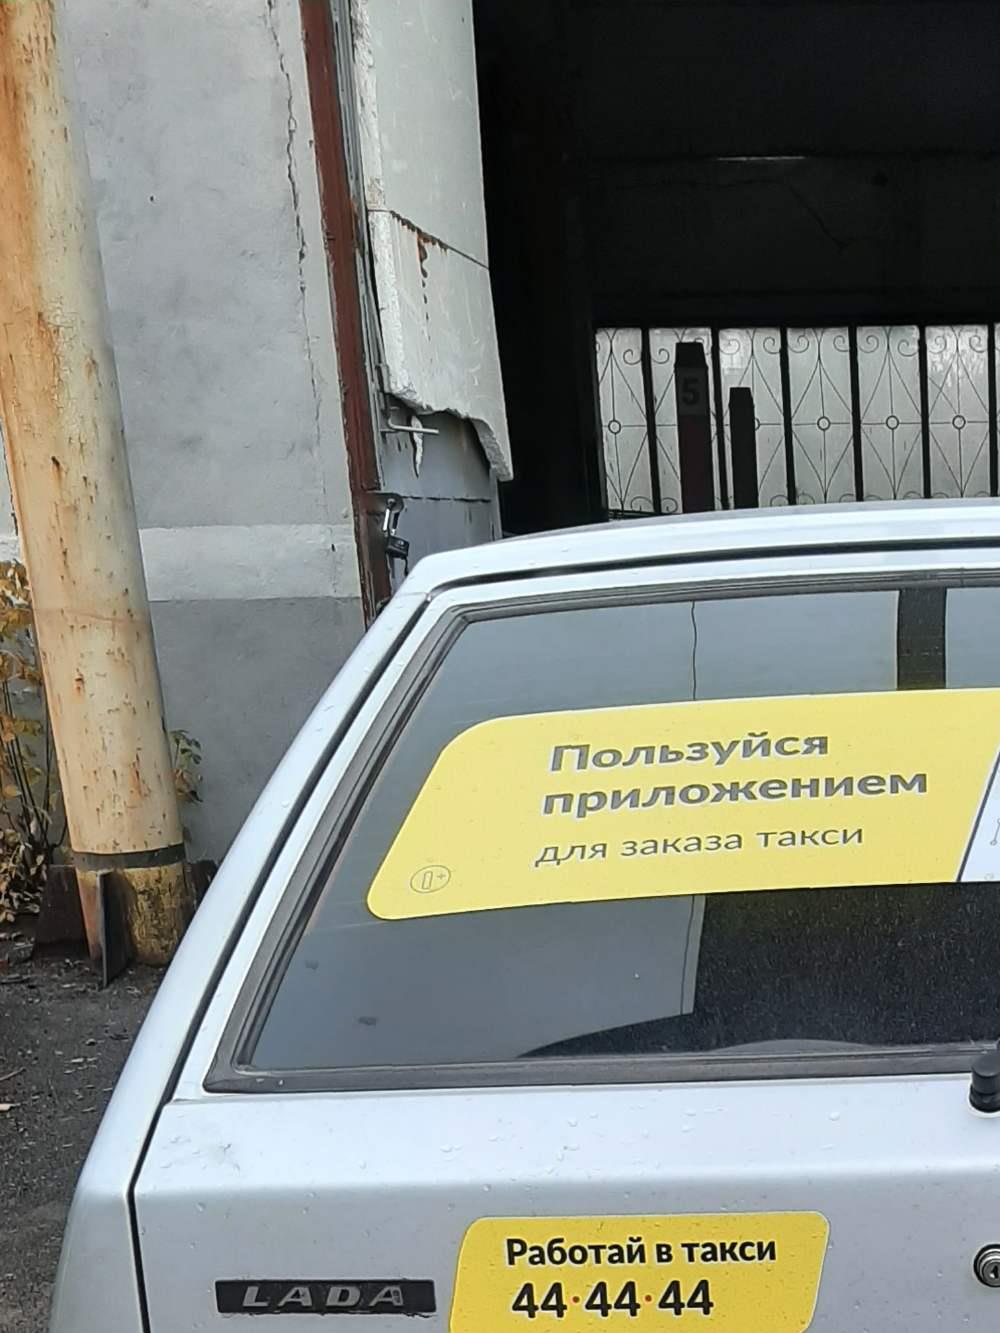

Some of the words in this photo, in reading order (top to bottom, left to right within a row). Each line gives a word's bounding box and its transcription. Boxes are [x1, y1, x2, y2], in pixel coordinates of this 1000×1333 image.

[682, 377, 699, 406] 5
[549, 732, 829, 773] Пользуйся
[541, 771, 928, 818] приложением
[534, 840, 607, 868] для
[620, 834, 742, 858] заказа
[757, 826, 863, 850] такси
[506, 1236, 646, 1267] Работай
[656, 1243, 673, 1263] в
[682, 1238, 777, 1263] такси
[242, 1284, 406, 1308] LADA
